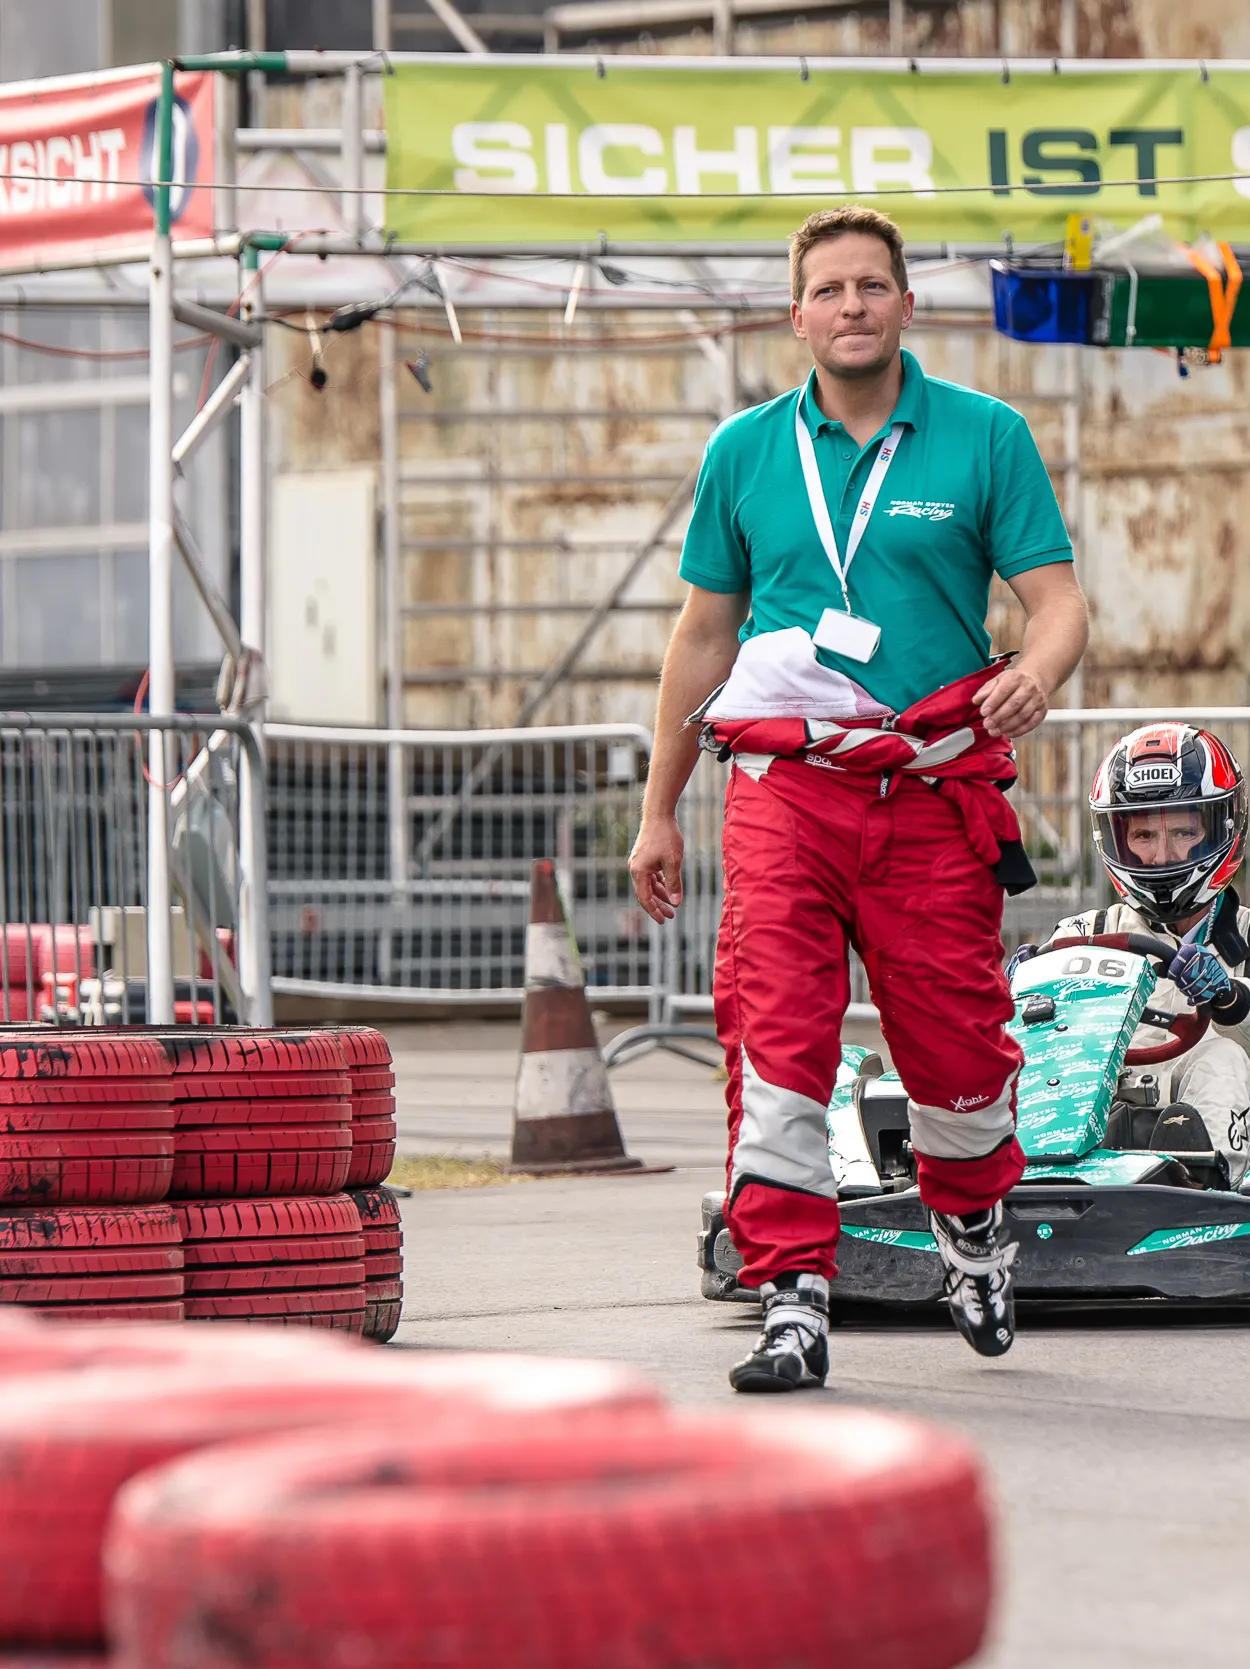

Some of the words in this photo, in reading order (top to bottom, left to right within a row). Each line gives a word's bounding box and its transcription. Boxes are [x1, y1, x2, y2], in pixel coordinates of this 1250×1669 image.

[451, 121, 937, 199] SICHER
[986, 127, 1185, 197] IST
[1133, 767, 1173, 783] SHOEI
[1162, 1227, 1203, 1245] NORMAN
